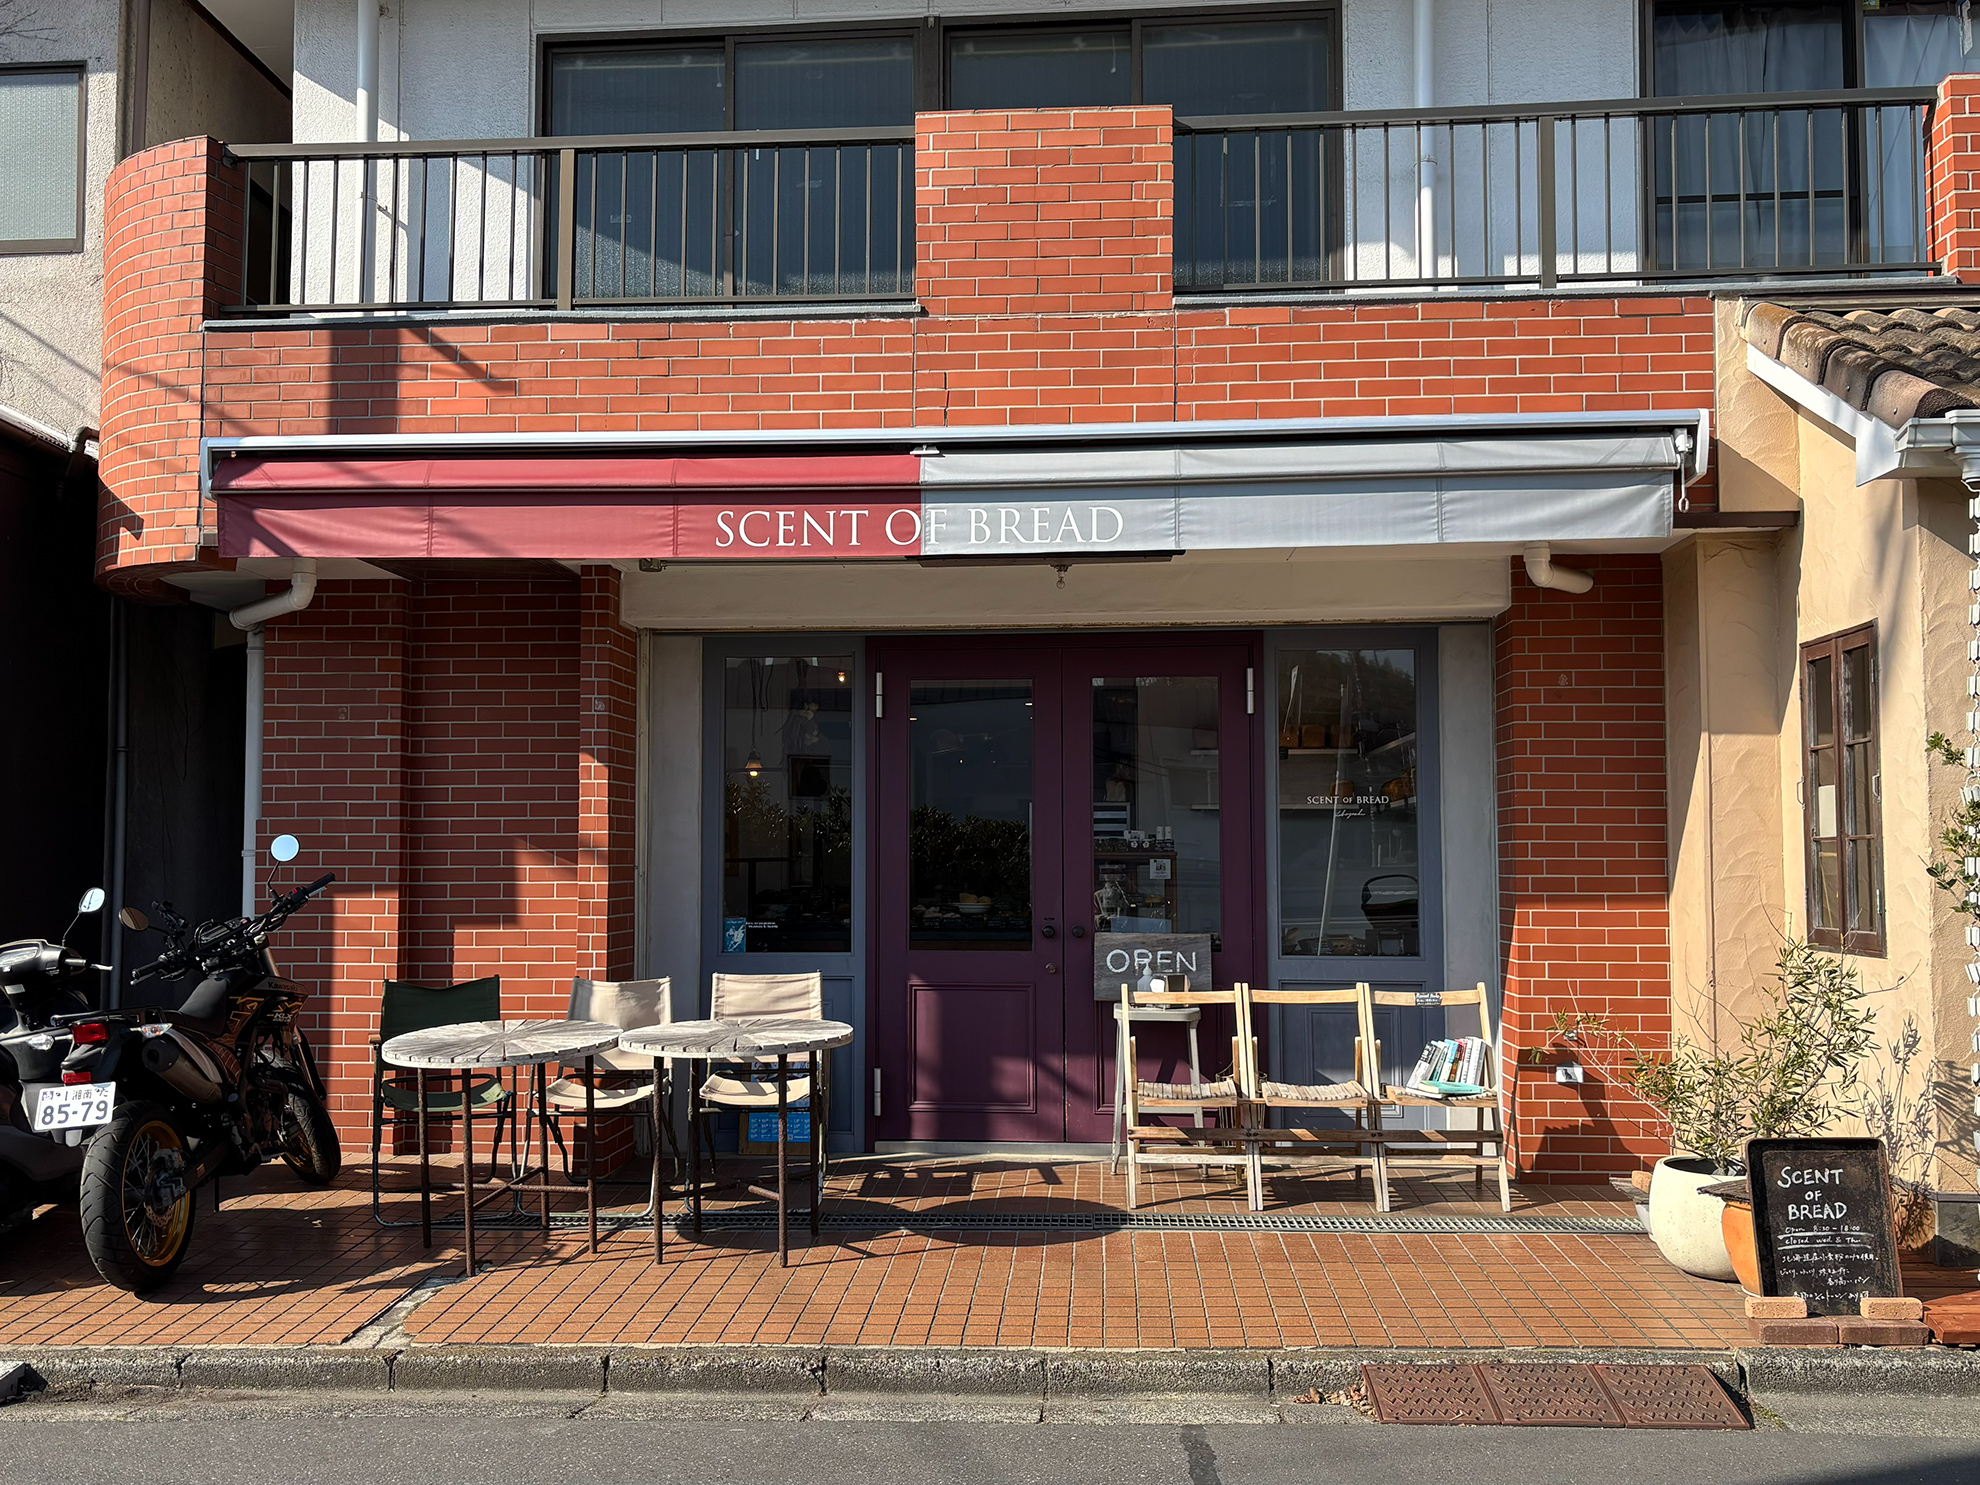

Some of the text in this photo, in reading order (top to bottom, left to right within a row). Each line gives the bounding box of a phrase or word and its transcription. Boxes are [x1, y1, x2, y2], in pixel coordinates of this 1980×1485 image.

[715, 506, 1124, 548] SCENT OF BREAD
[1306, 795, 1340, 805] SCENT
[1356, 795, 1390, 804] BREAD
[1106, 949, 1197, 975] OPEN
[41, 1100, 108, 1125] 85-79
[1777, 1166, 1843, 1188] SCENT
[1805, 1190, 1822, 1201] OF
[1788, 1202, 1847, 1220] BREAD
